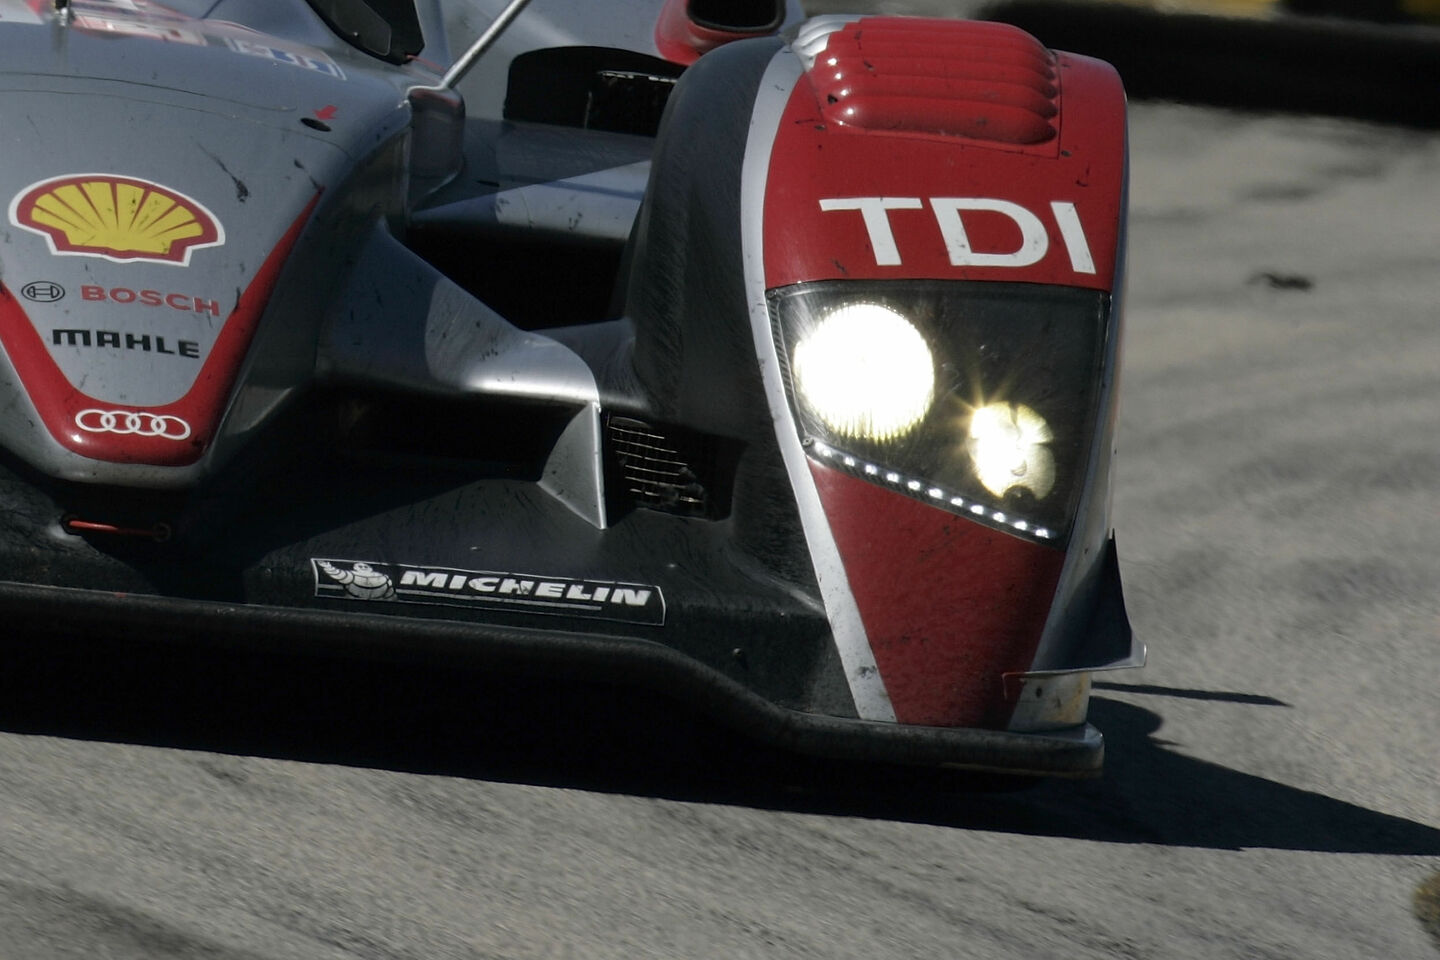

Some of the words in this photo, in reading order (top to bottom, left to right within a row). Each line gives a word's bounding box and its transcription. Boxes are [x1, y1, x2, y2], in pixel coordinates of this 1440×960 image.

[818, 196, 1097, 274] TDI
[81, 285, 220, 316] BOSCH
[52, 329, 200, 358] MAHLE
[399, 570, 651, 606] MICHELIN
